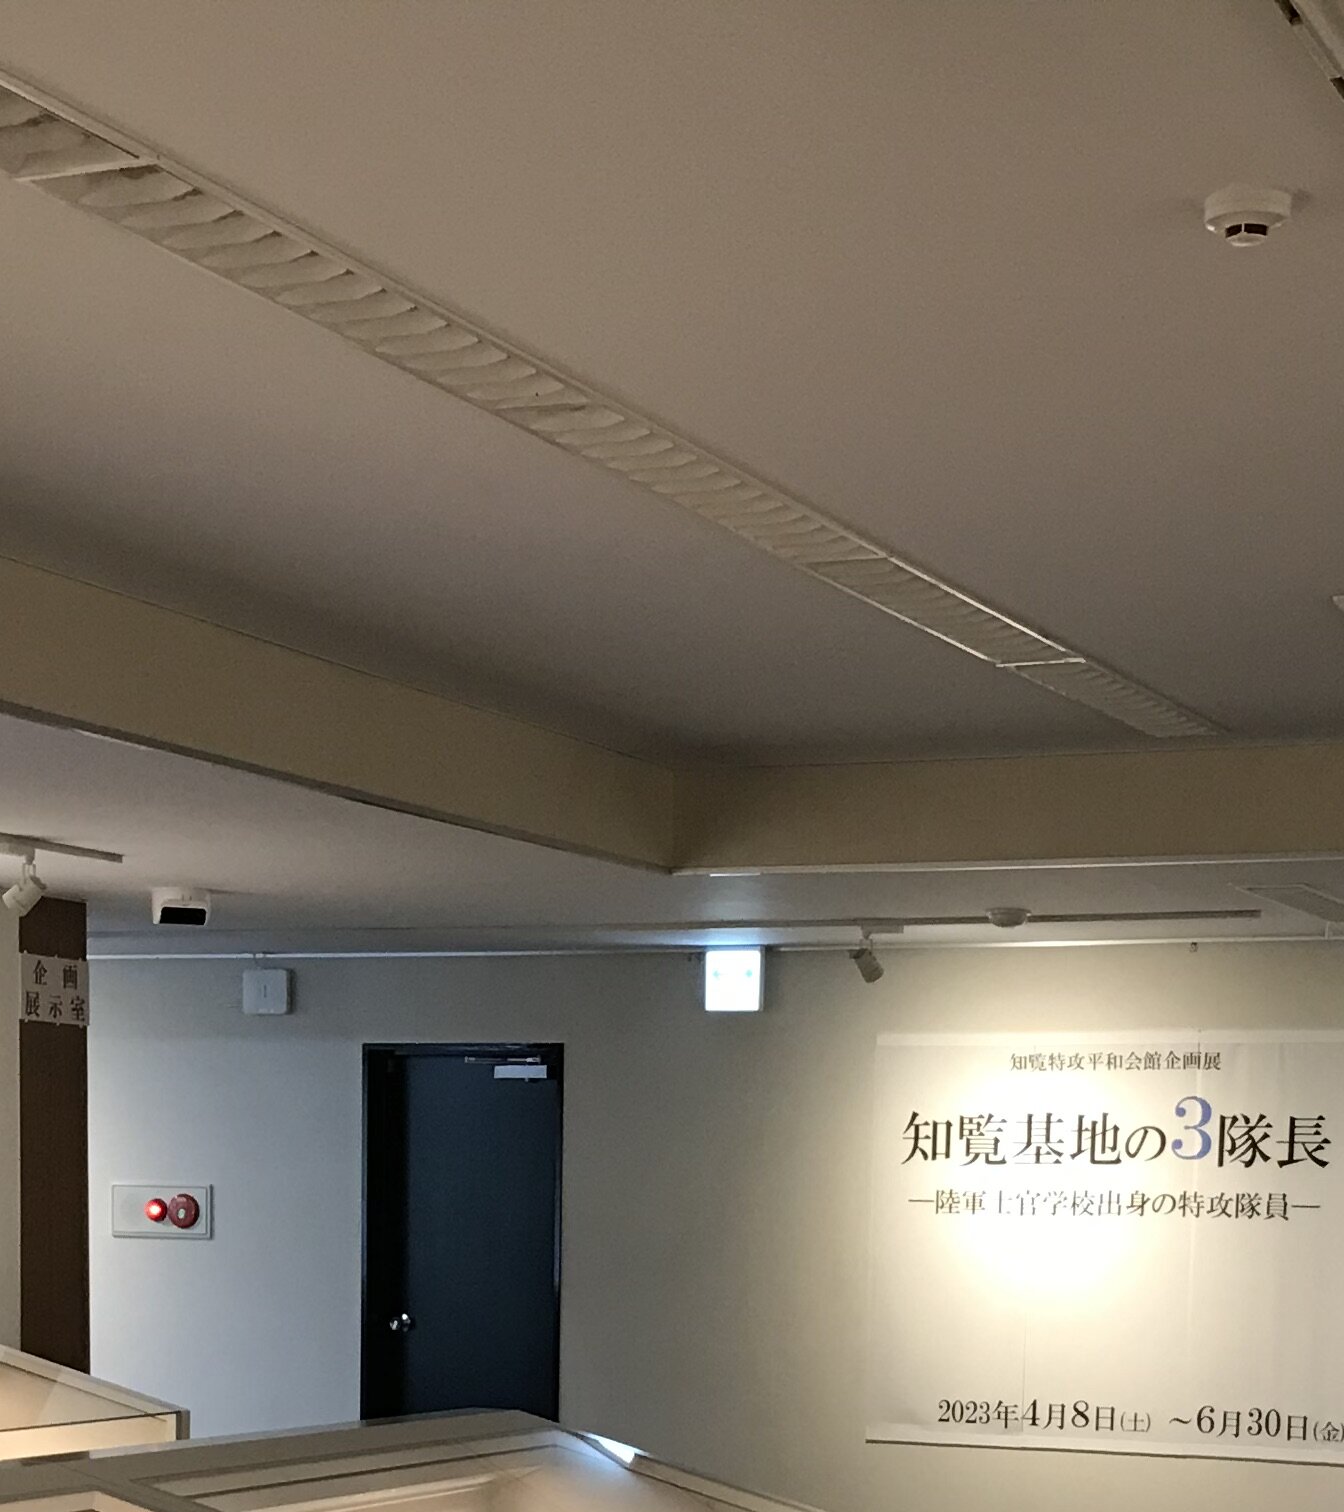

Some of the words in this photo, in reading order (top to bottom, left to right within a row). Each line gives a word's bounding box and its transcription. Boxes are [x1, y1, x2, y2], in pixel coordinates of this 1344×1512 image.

[32, 959, 79, 990] 企画
[24, 991, 86, 1022] 展示室
[1010, 1050, 1222, 1072] 知覧特攻平和会館企画展
[900, 1095, 1333, 1169] 知覧基地の3隊長
